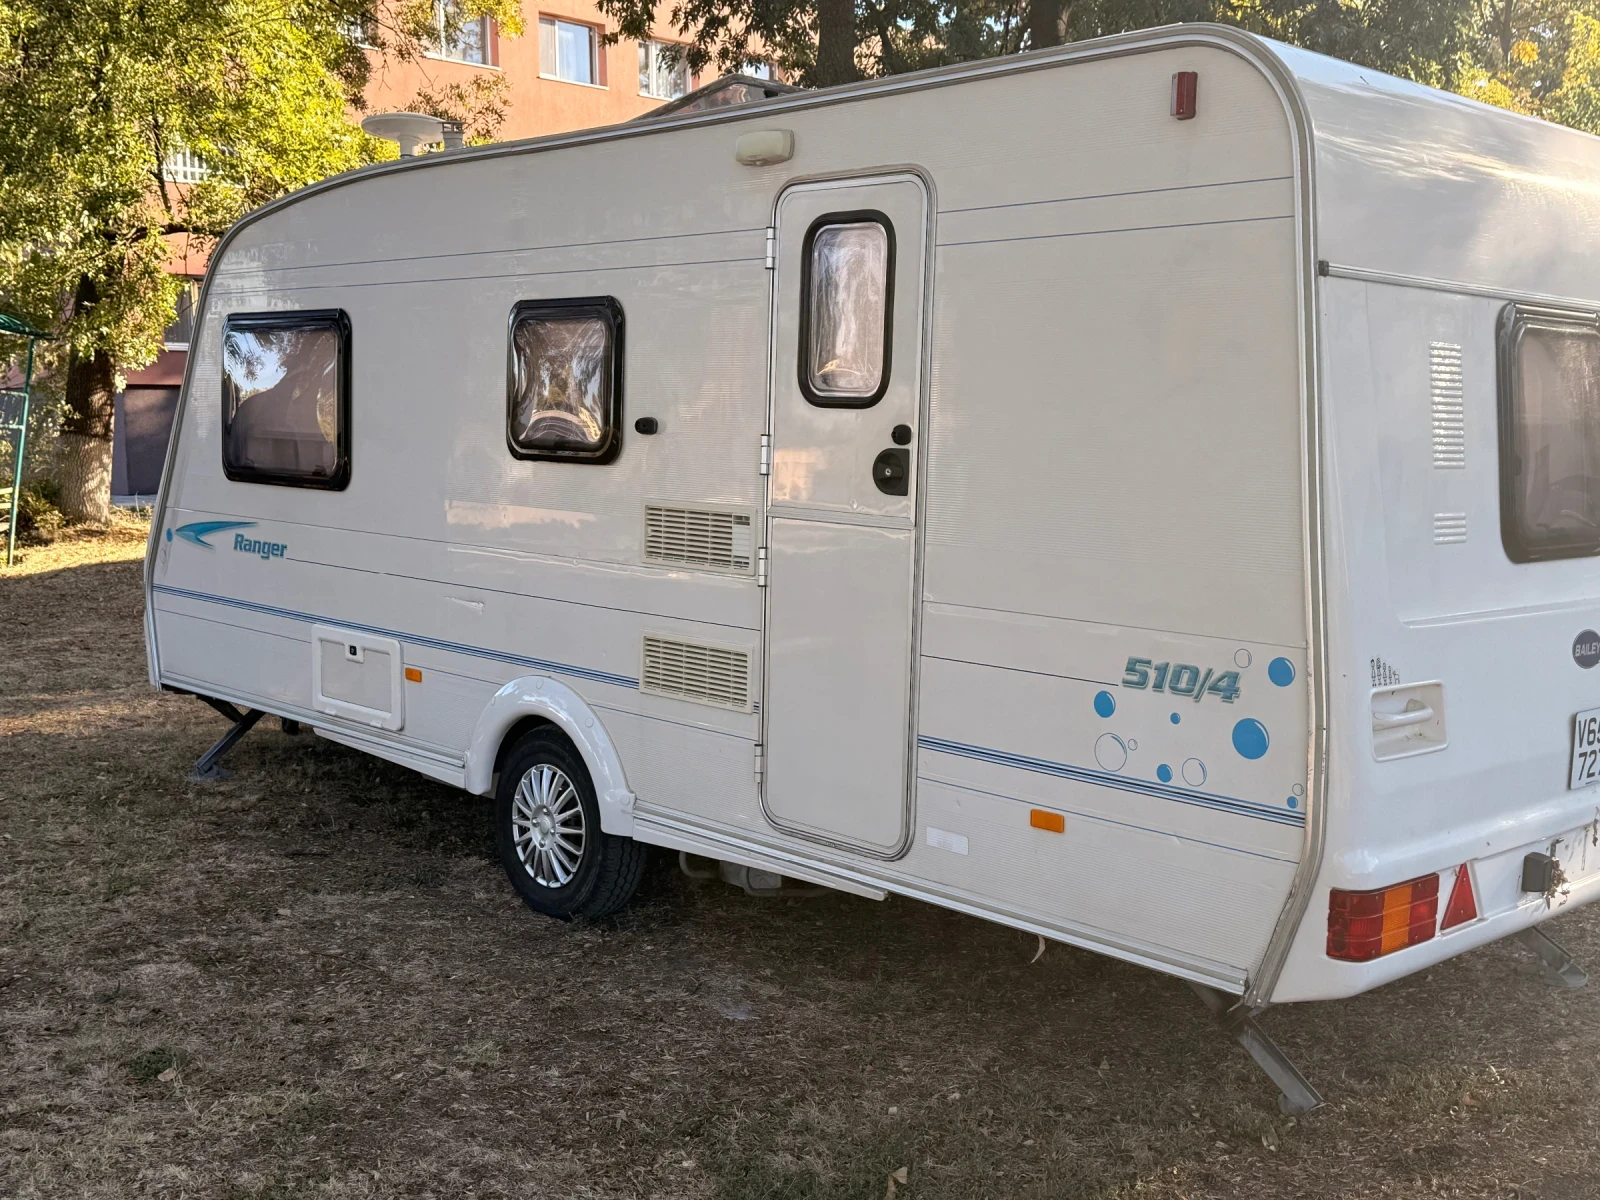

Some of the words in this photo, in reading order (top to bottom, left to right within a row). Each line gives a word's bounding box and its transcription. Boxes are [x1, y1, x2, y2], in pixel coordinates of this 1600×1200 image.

[233, 533, 287, 560] Ranger
[1575, 641, 1600, 657] BAILEY
[1122, 656, 1241, 704] 510/4
[1578, 748, 1600, 781] 72
